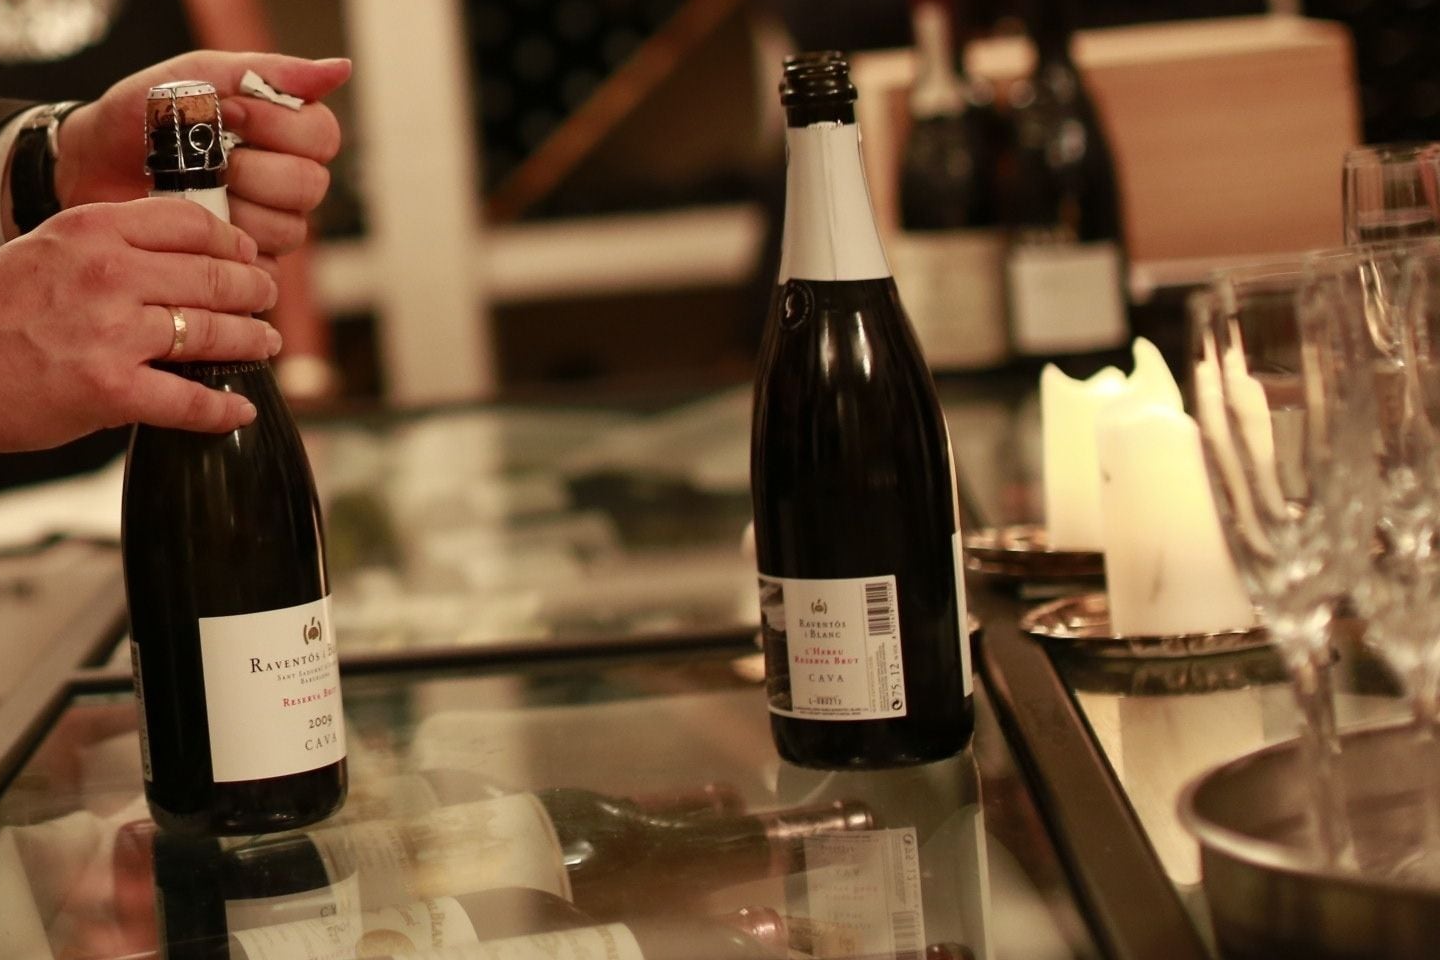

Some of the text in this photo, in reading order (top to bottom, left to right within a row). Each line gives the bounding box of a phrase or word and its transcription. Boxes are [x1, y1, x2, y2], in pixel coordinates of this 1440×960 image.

[250, 652, 320, 673] RAVENTÓS
[889, 663, 900, 676] 12
[809, 673, 844, 683] CAVA
[891, 683, 902, 698] 75
[308, 714, 333, 729] 2009
